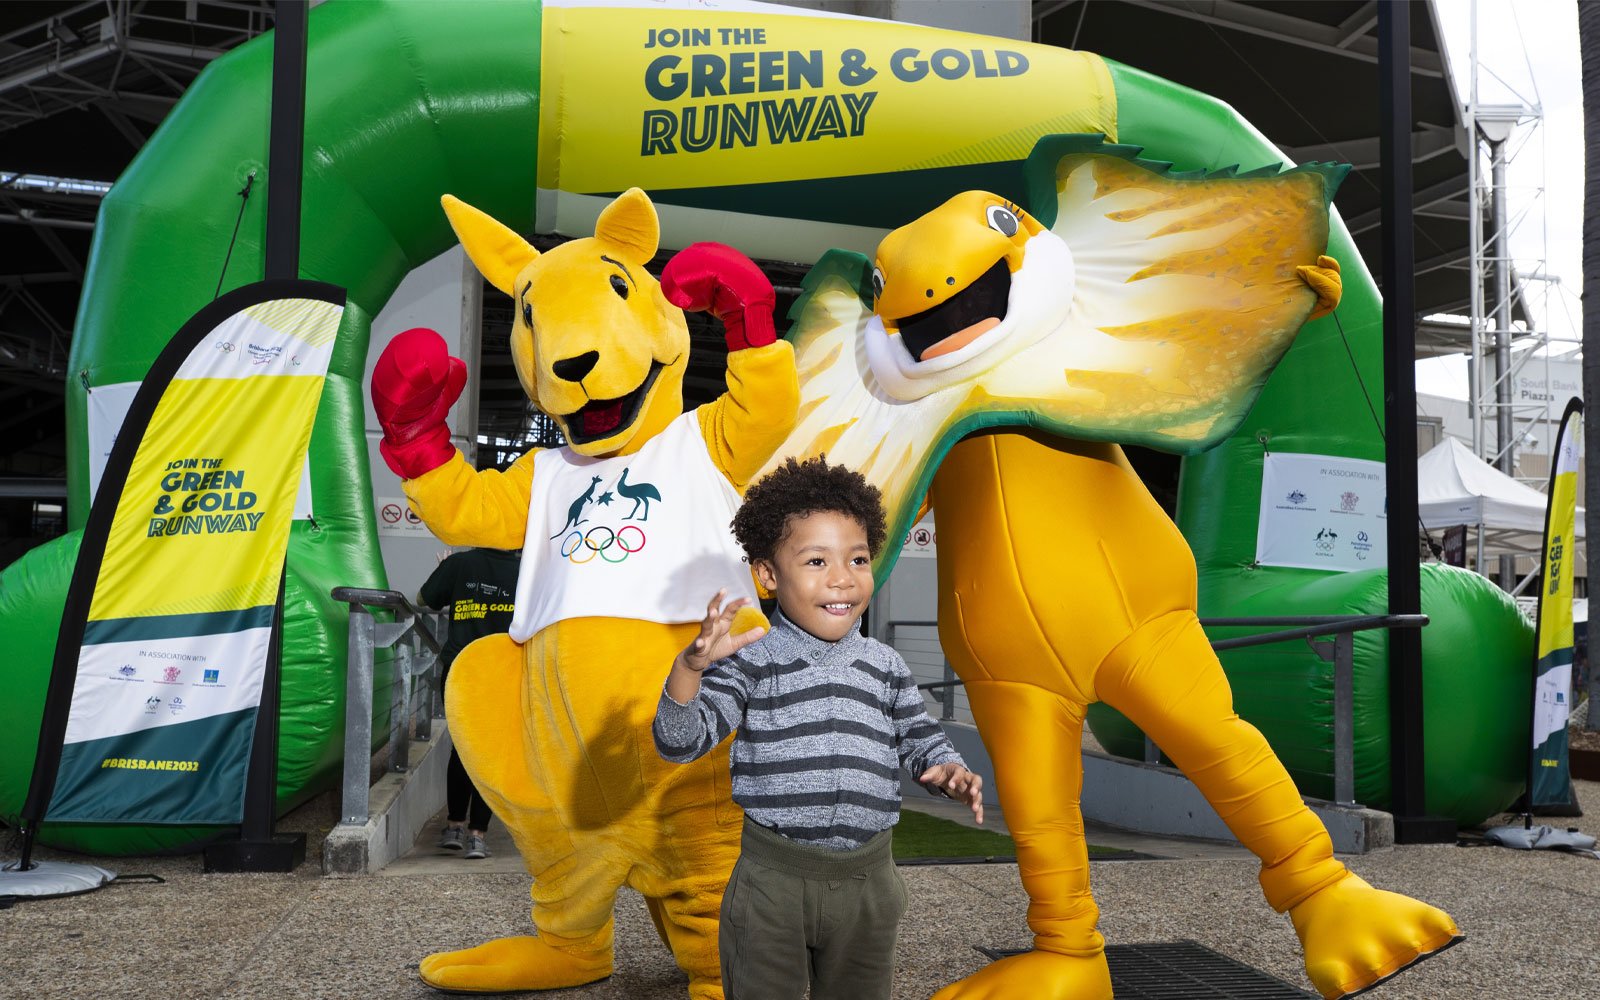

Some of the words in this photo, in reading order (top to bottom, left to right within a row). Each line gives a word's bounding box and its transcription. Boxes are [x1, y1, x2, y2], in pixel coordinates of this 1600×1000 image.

[644, 28, 711, 48] JOIN
[717, 28, 767, 46] THE
[644, 50, 824, 102] GREEN
[838, 48, 878, 87] &
[889, 47, 1030, 82] GOLD
[640, 91, 879, 157] RUNWAY
[1552, 380, 1578, 391] Bank
[1521, 390, 1555, 402] Piazza
[165, 458, 199, 471] JOIN
[201, 458, 224, 469] THE
[160, 470, 245, 493] GREEN
[1328, 468, 1366, 480] ASSOCIATION
[1367, 473, 1380, 481] WITH
[153, 494, 175, 515] &
[181, 491, 257, 513] GOLD
[147, 512, 266, 538] RUNWAY
[454, 602, 480, 613] GREEN
[480, 603, 488, 611] &
[489, 603, 515, 612] GOLD
[148, 651, 192, 661] ASSOCIATION
[101, 758, 199, 772] #BRISBANE2032
